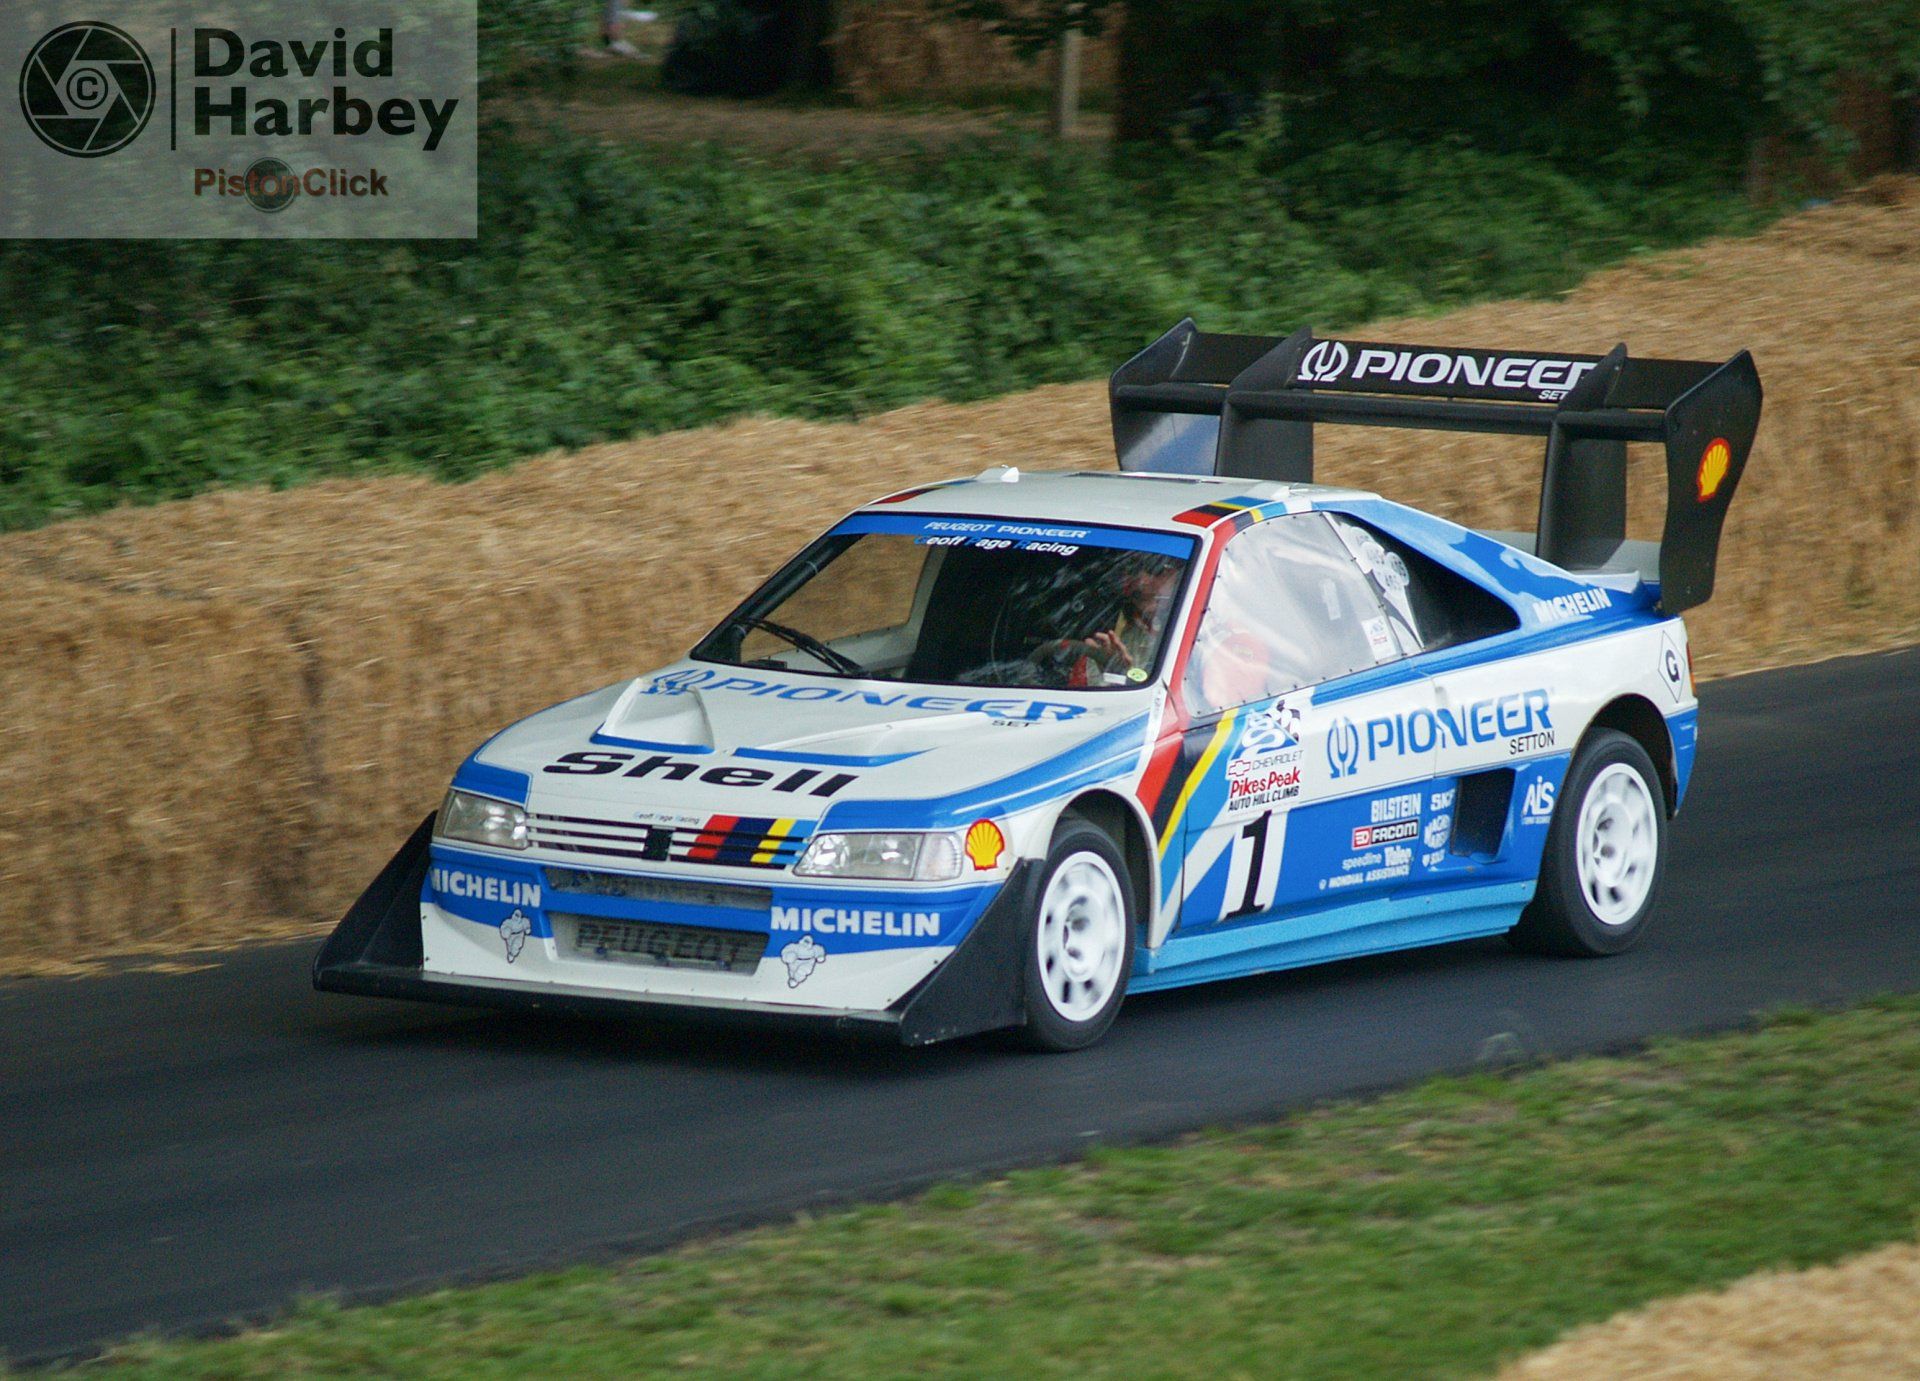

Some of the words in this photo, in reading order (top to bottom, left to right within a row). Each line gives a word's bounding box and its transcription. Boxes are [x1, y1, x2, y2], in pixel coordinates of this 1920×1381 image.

[924, 521, 995, 533] PEUGEOT
[997, 525, 1088, 539] PIONEER
[914, 535, 966, 547] Geoff
[966, 538, 1012, 550] Page
[1014, 539, 1079, 556] Racing
[1533, 587, 1612, 624] MICHELIN
[1665, 650, 1680, 682] G
[703, 676, 1088, 722] PIONEER
[1367, 688, 1553, 762] PIONEER
[1509, 730, 1556, 755] SETTON
[542, 752, 858, 797] Shell
[1252, 751, 1303, 770] CHEVROLET
[1228, 796, 1251, 811] AUTO
[1252, 792, 1271, 806] HILL
[1272, 785, 1299, 802] CLIMB
[1229, 778, 1265, 799] Pikes
[1267, 767, 1300, 790] Peak
[1371, 793, 1421, 823] BILSTEIN
[1372, 821, 1418, 843] FACOM
[1226, 810, 1272, 920] 1
[771, 906, 940, 936] MICHELIN
